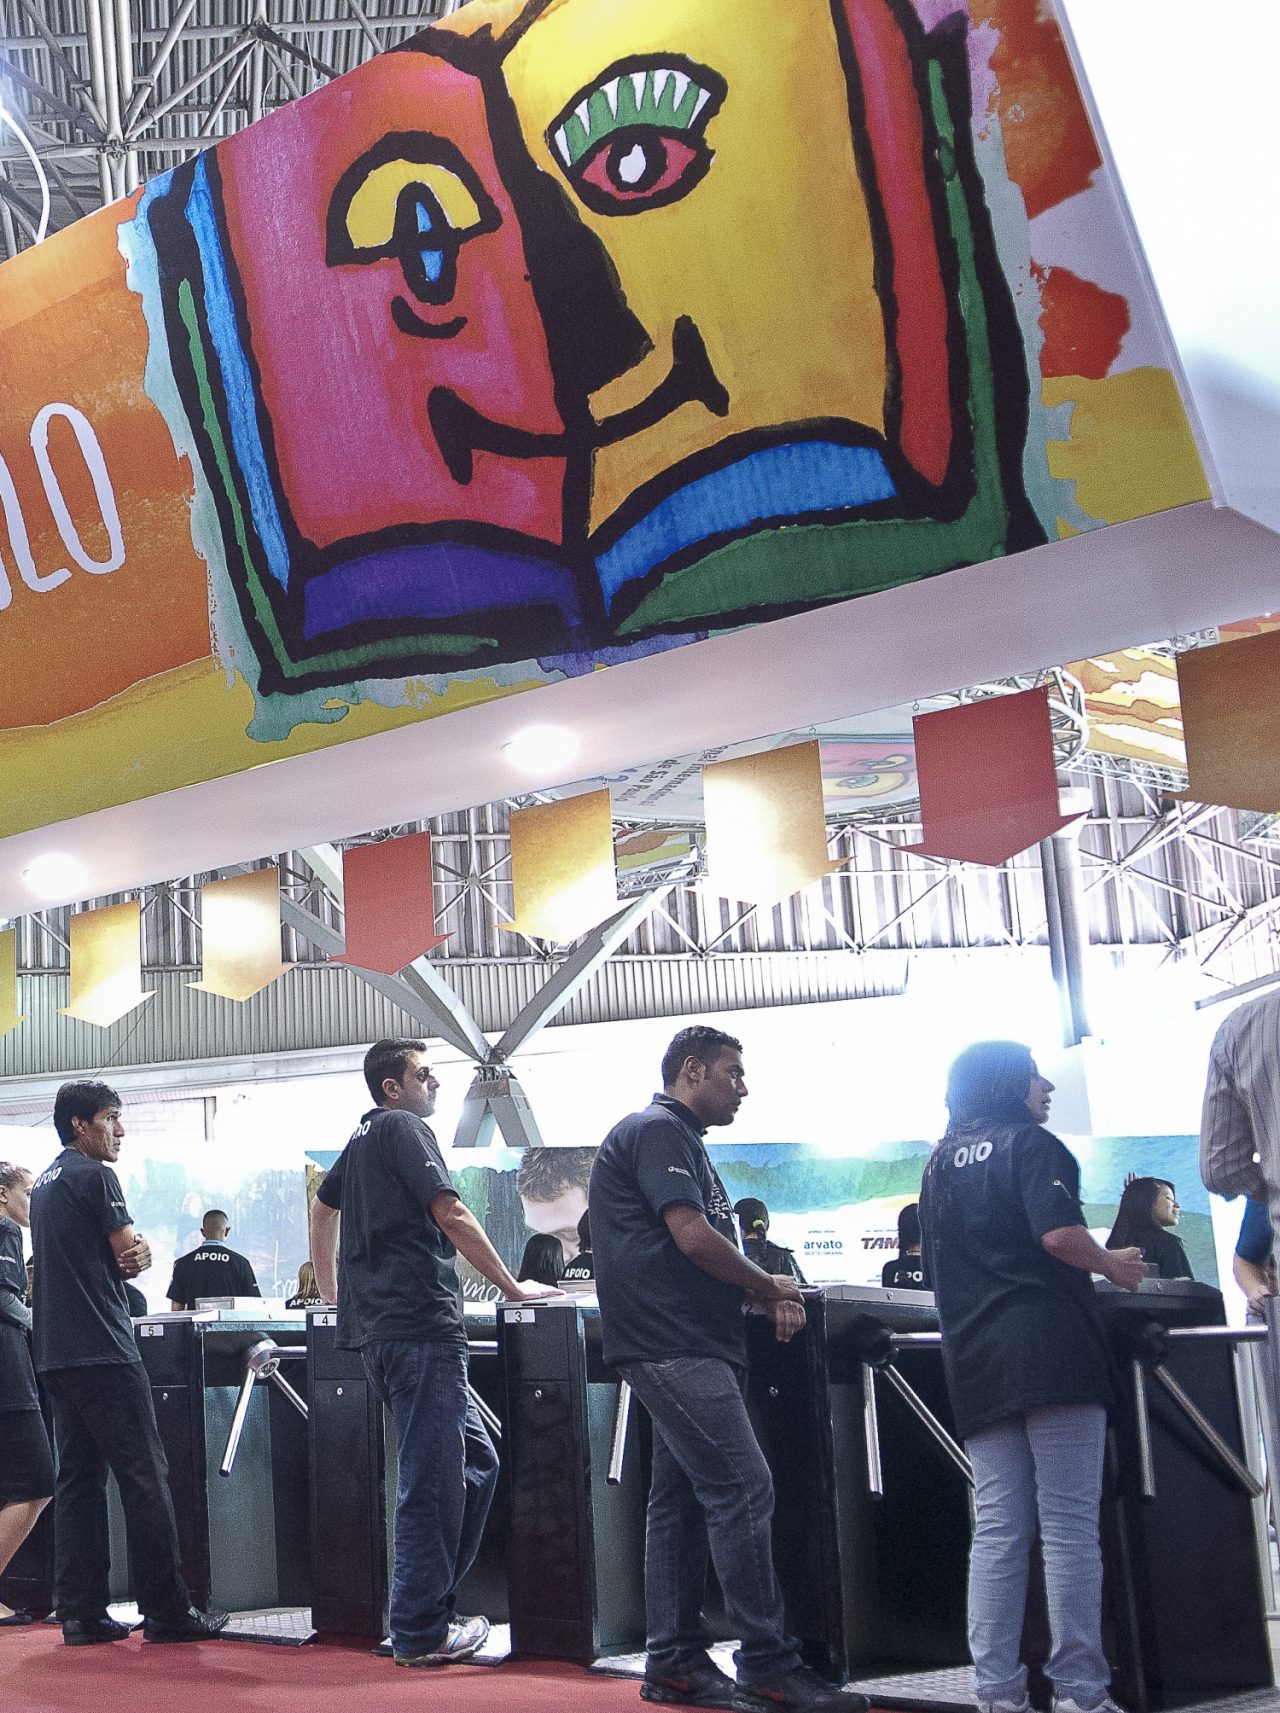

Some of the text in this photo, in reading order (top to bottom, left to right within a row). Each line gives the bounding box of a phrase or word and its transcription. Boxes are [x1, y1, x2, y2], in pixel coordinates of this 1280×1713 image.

[804, 1239, 843, 1250] arvato
[194, 1252, 231, 1263] APOIO
[564, 1267, 591, 1280] APOIO
[289, 1298, 323, 1308] APOIO
[321, 1314, 329, 1326] 4
[514, 1310, 523, 1323] 3
[148, 1325, 155, 1336] 5
